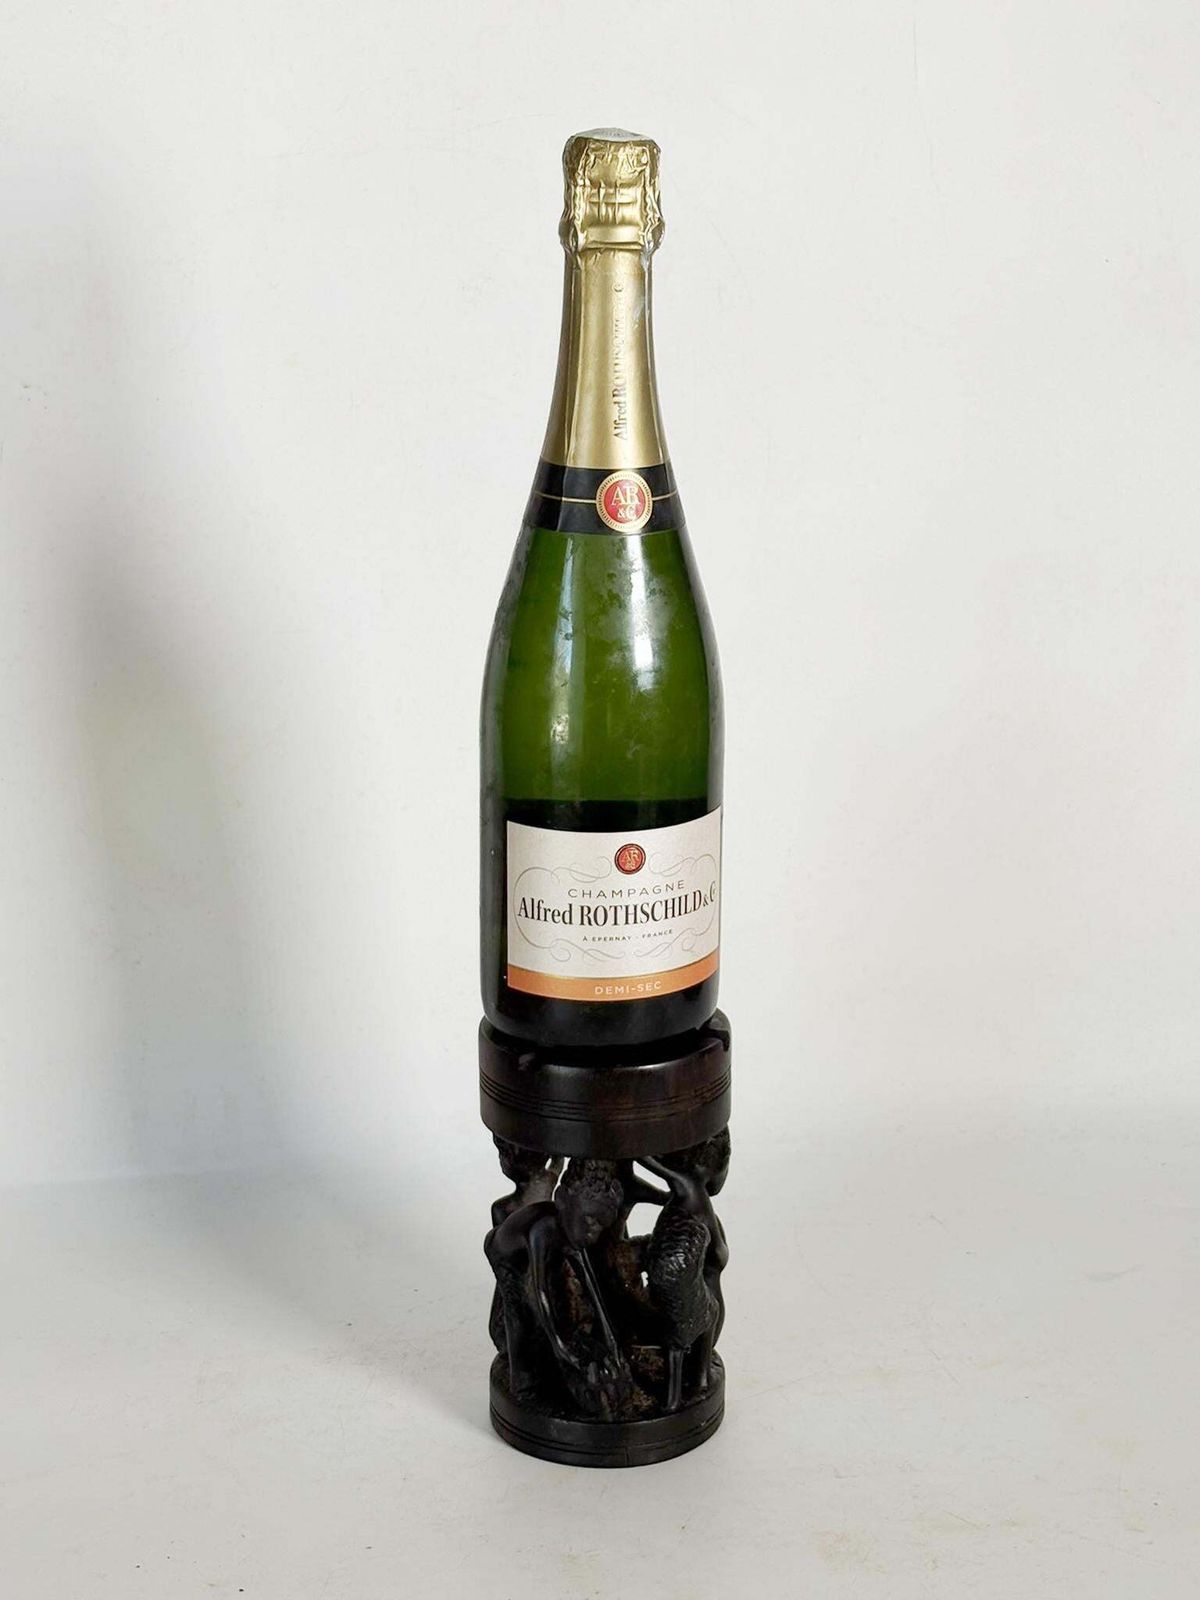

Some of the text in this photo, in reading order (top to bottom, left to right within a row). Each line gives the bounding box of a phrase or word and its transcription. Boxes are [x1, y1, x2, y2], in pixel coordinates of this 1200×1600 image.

[613, 402, 627, 441] Alfred
[567, 880, 685, 899] CHAMPAGNE
[517, 897, 574, 925] Alfred
[579, 889, 702, 926] ROTHSCHILD
[642, 928, 673, 939] FRANCE
[594, 981, 662, 995] DEMI-SEC
